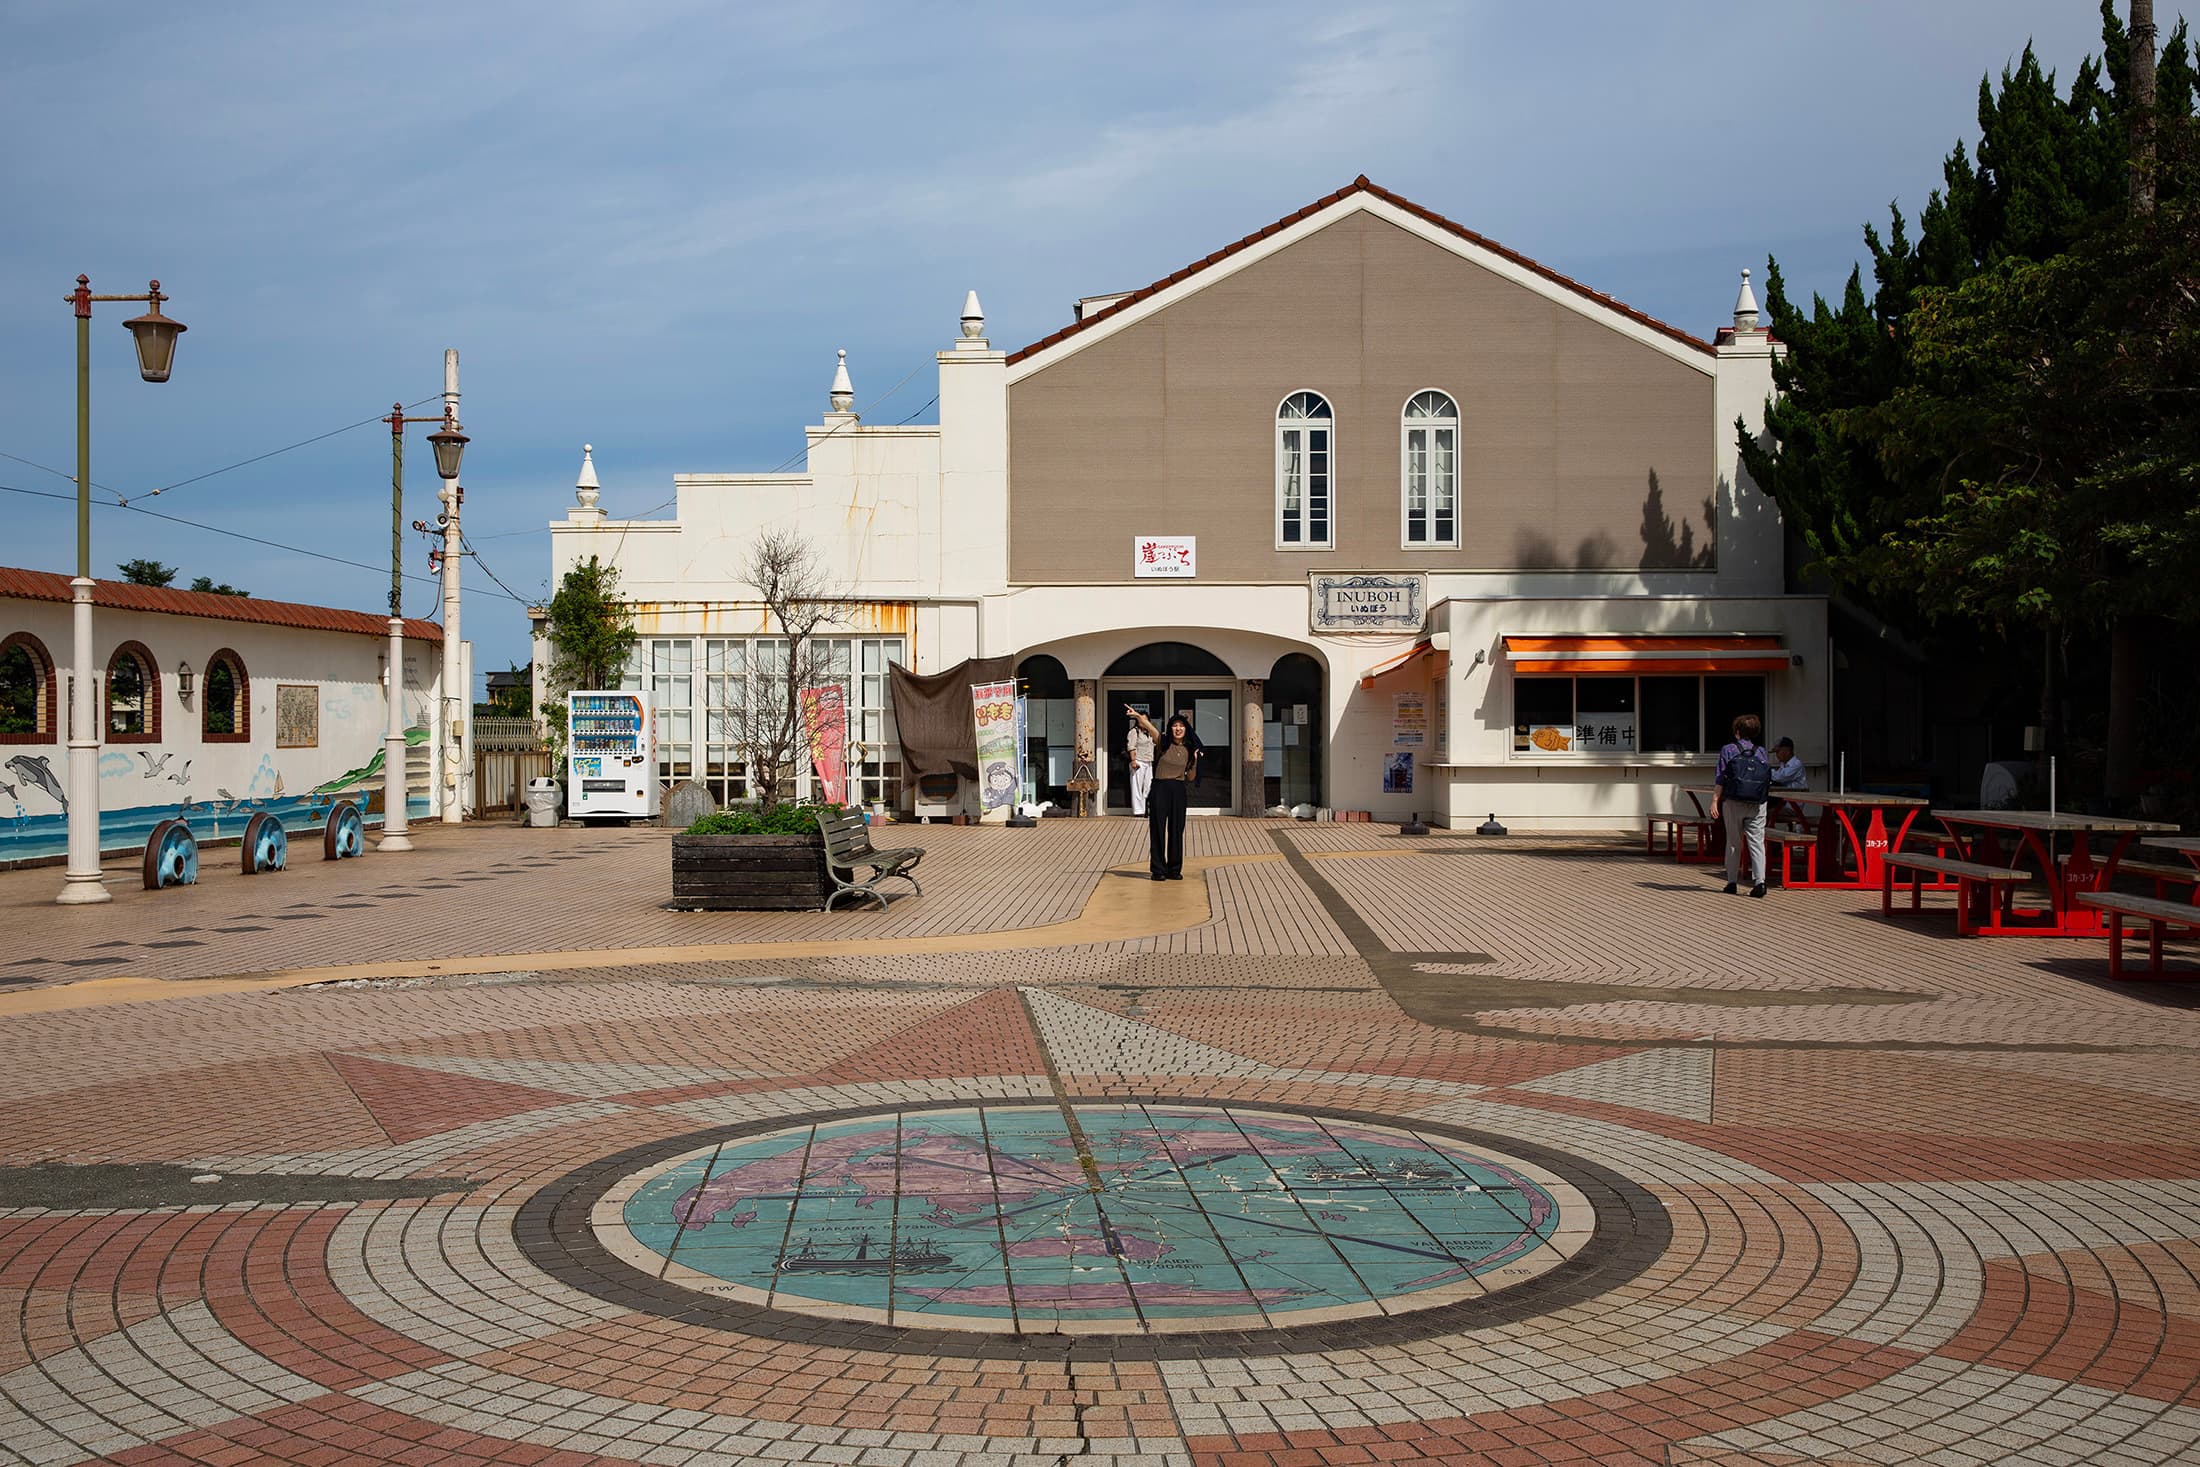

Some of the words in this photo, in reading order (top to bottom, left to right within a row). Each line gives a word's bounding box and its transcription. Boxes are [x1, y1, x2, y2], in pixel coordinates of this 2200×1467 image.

[1337, 591, 1400, 602] INUBOH
[1351, 604, 1387, 613] いぬぼう
[1576, 724, 1635, 745] 準備中
